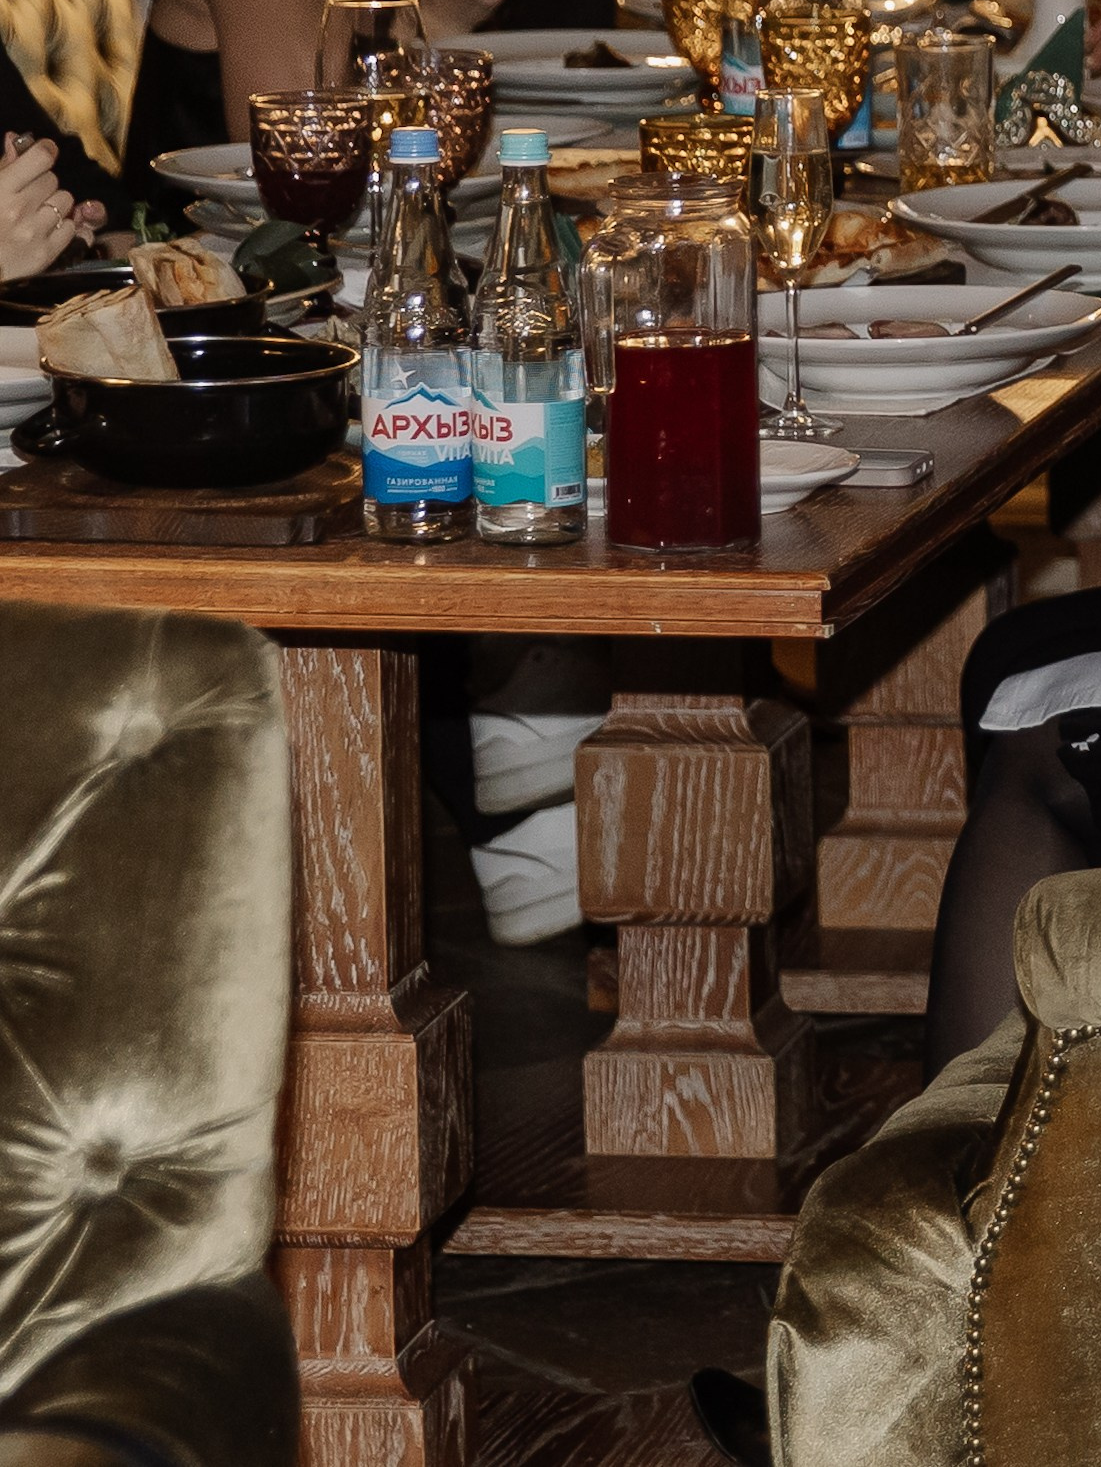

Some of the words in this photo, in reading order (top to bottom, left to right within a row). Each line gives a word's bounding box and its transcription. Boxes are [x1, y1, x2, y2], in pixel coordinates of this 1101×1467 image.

[371, 410, 470, 440] АРХЫЗ
[434, 442, 472, 462] VITA
[386, 476, 458, 486] ГАЗИРОВАННАЯ
